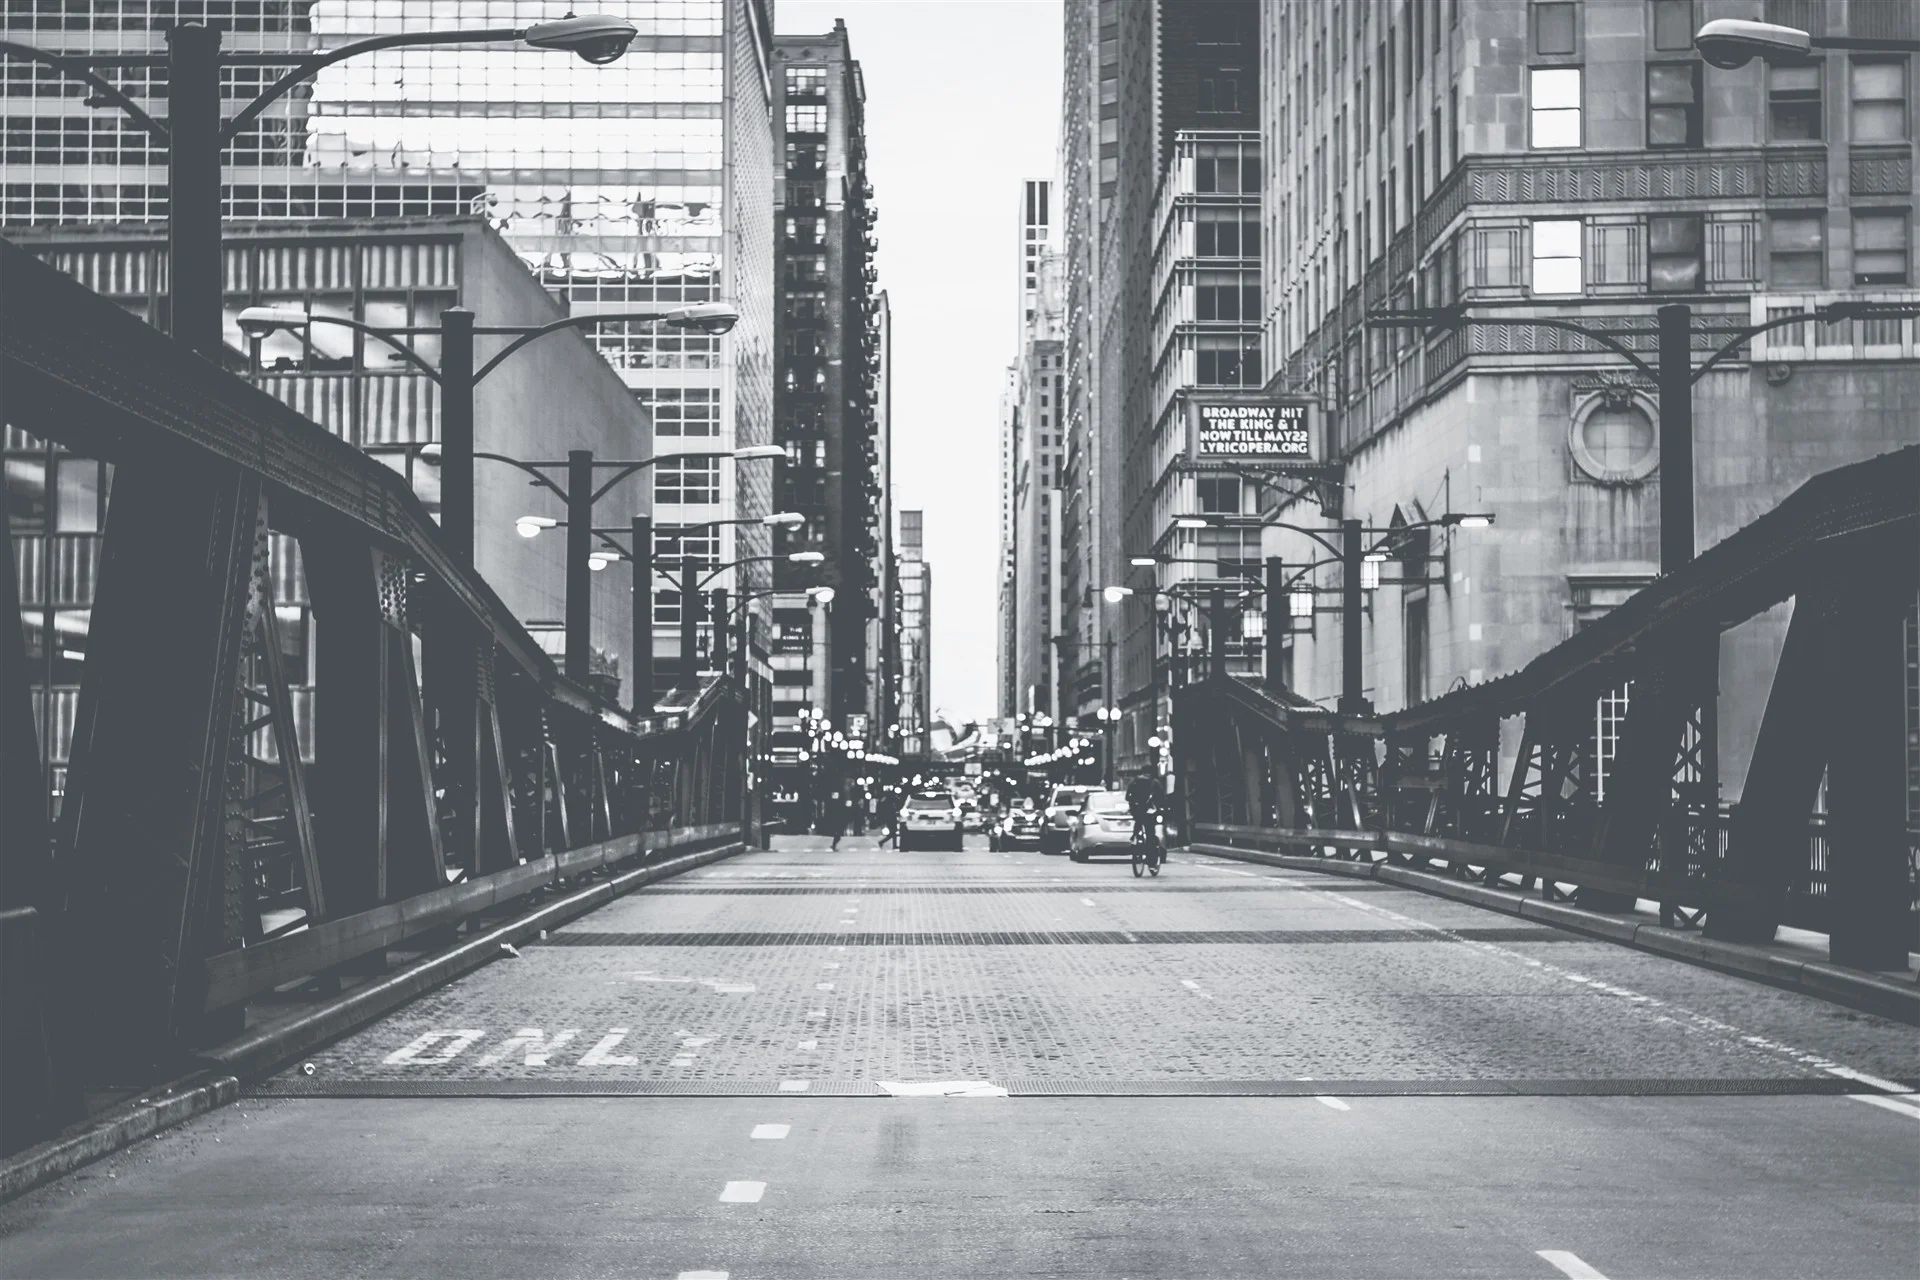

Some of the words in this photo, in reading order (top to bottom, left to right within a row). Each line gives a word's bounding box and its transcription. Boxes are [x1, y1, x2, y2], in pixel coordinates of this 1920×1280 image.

[1202, 407, 1276, 418] BROADWAY
[1281, 407, 1304, 418] HIT
[1208, 418, 1236, 430] THE
[1239, 418, 1274, 430] KING
[1277, 418, 1288, 430] &
[1200, 430, 1232, 442] NOW
[1232, 430, 1262, 442] TILL
[1200, 442, 1308, 453] LYRICOPERA.ORG
